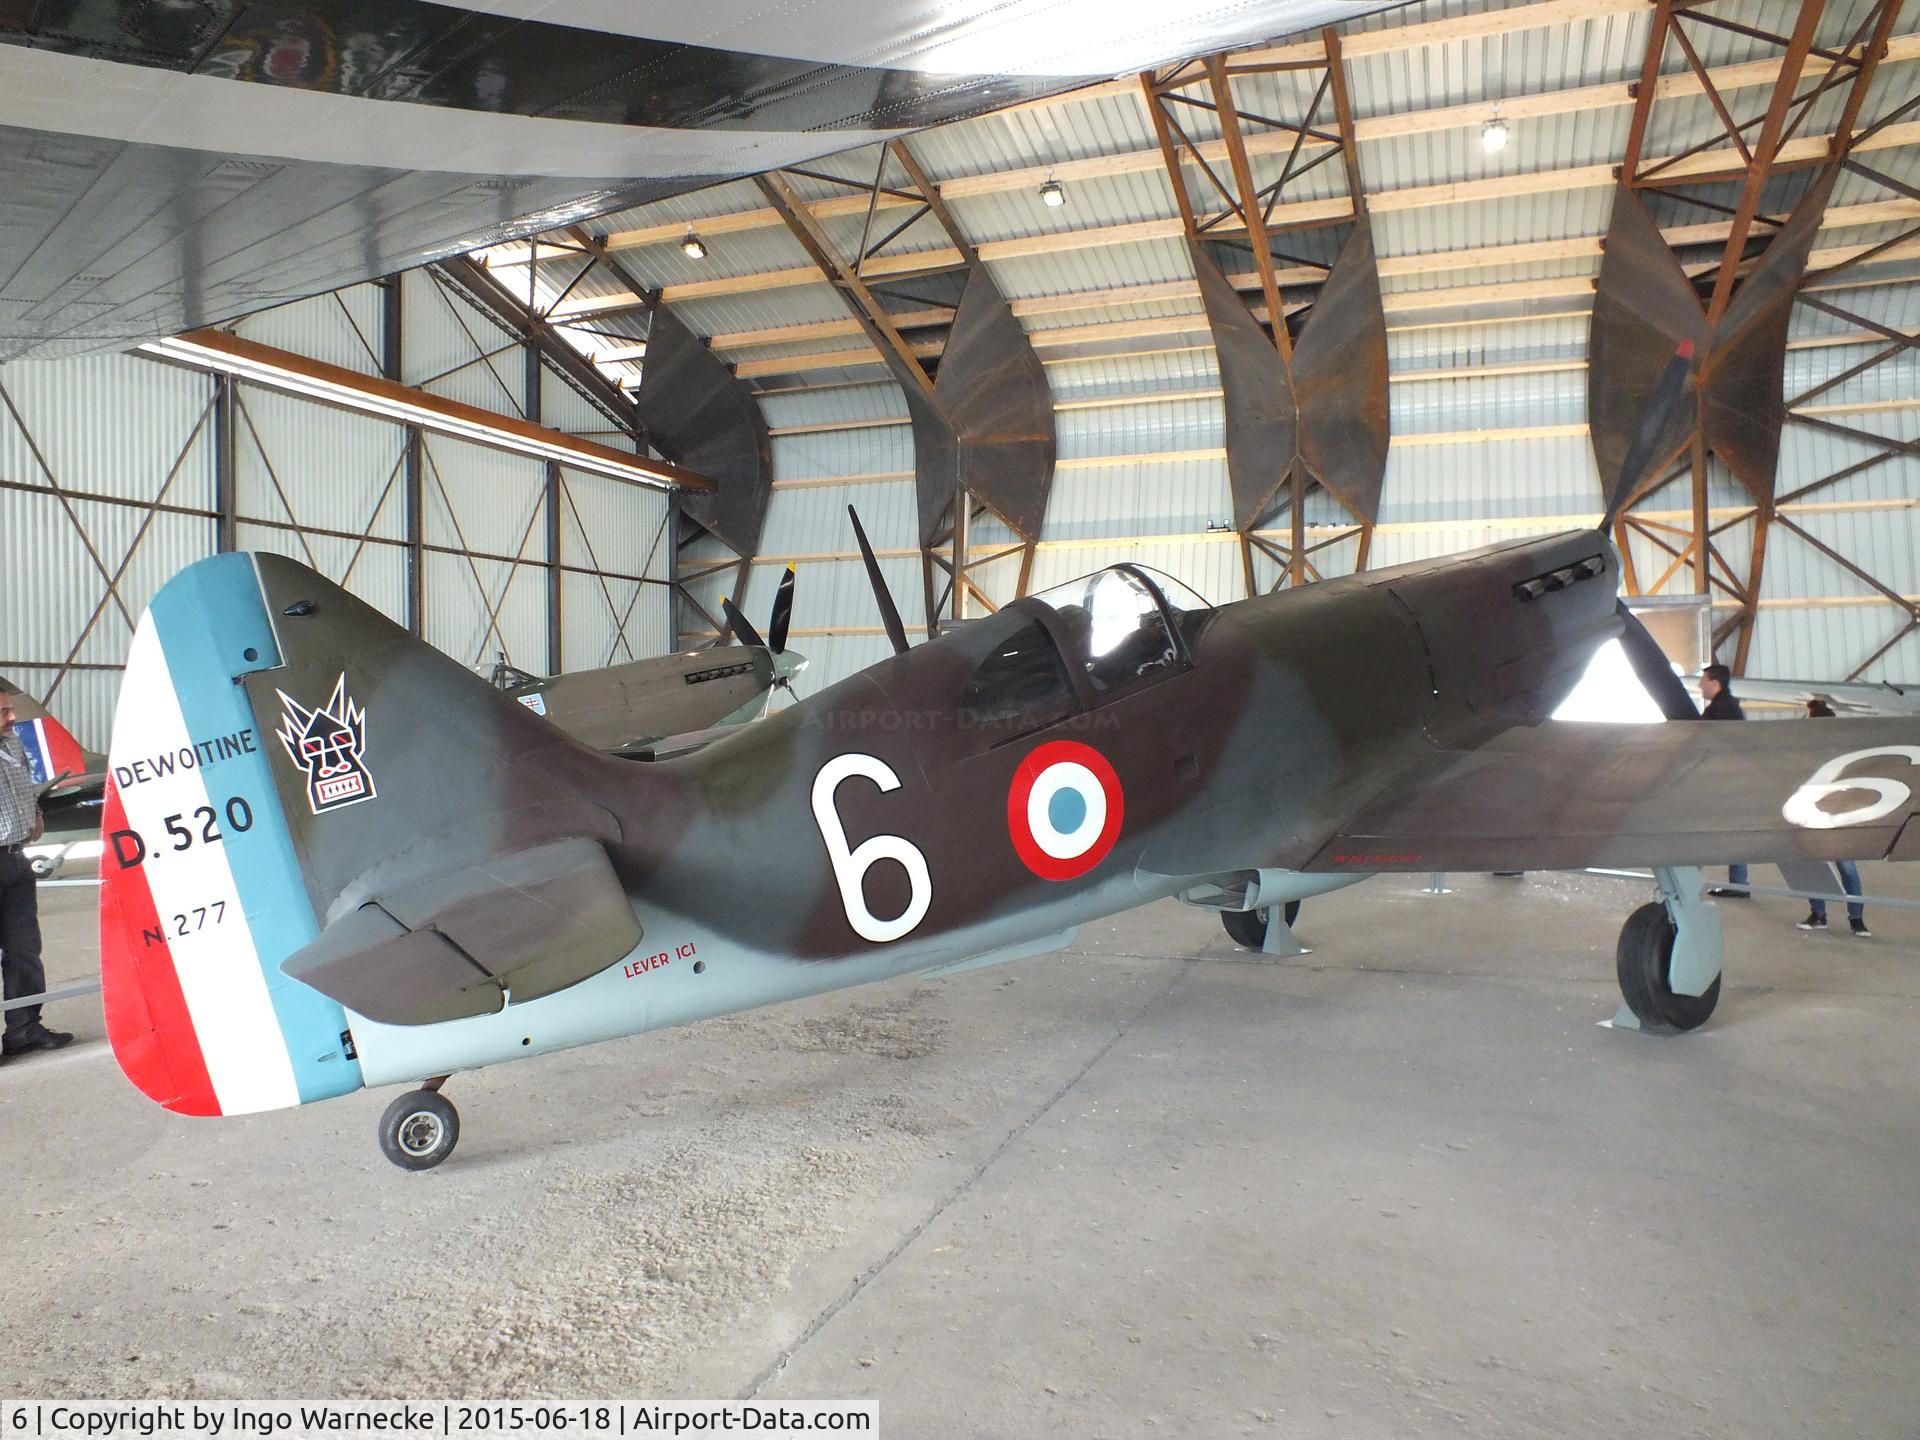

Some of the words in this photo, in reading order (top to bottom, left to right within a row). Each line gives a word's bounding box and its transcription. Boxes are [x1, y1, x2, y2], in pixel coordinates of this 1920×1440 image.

[114, 728, 257, 789] DEWOITINE
[1782, 744, 1920, 829] 6
[110, 796, 254, 870] D.520
[810, 752, 933, 943] 6
[623, 953, 670, 979] LEVER
[675, 942, 698, 961] ICI
